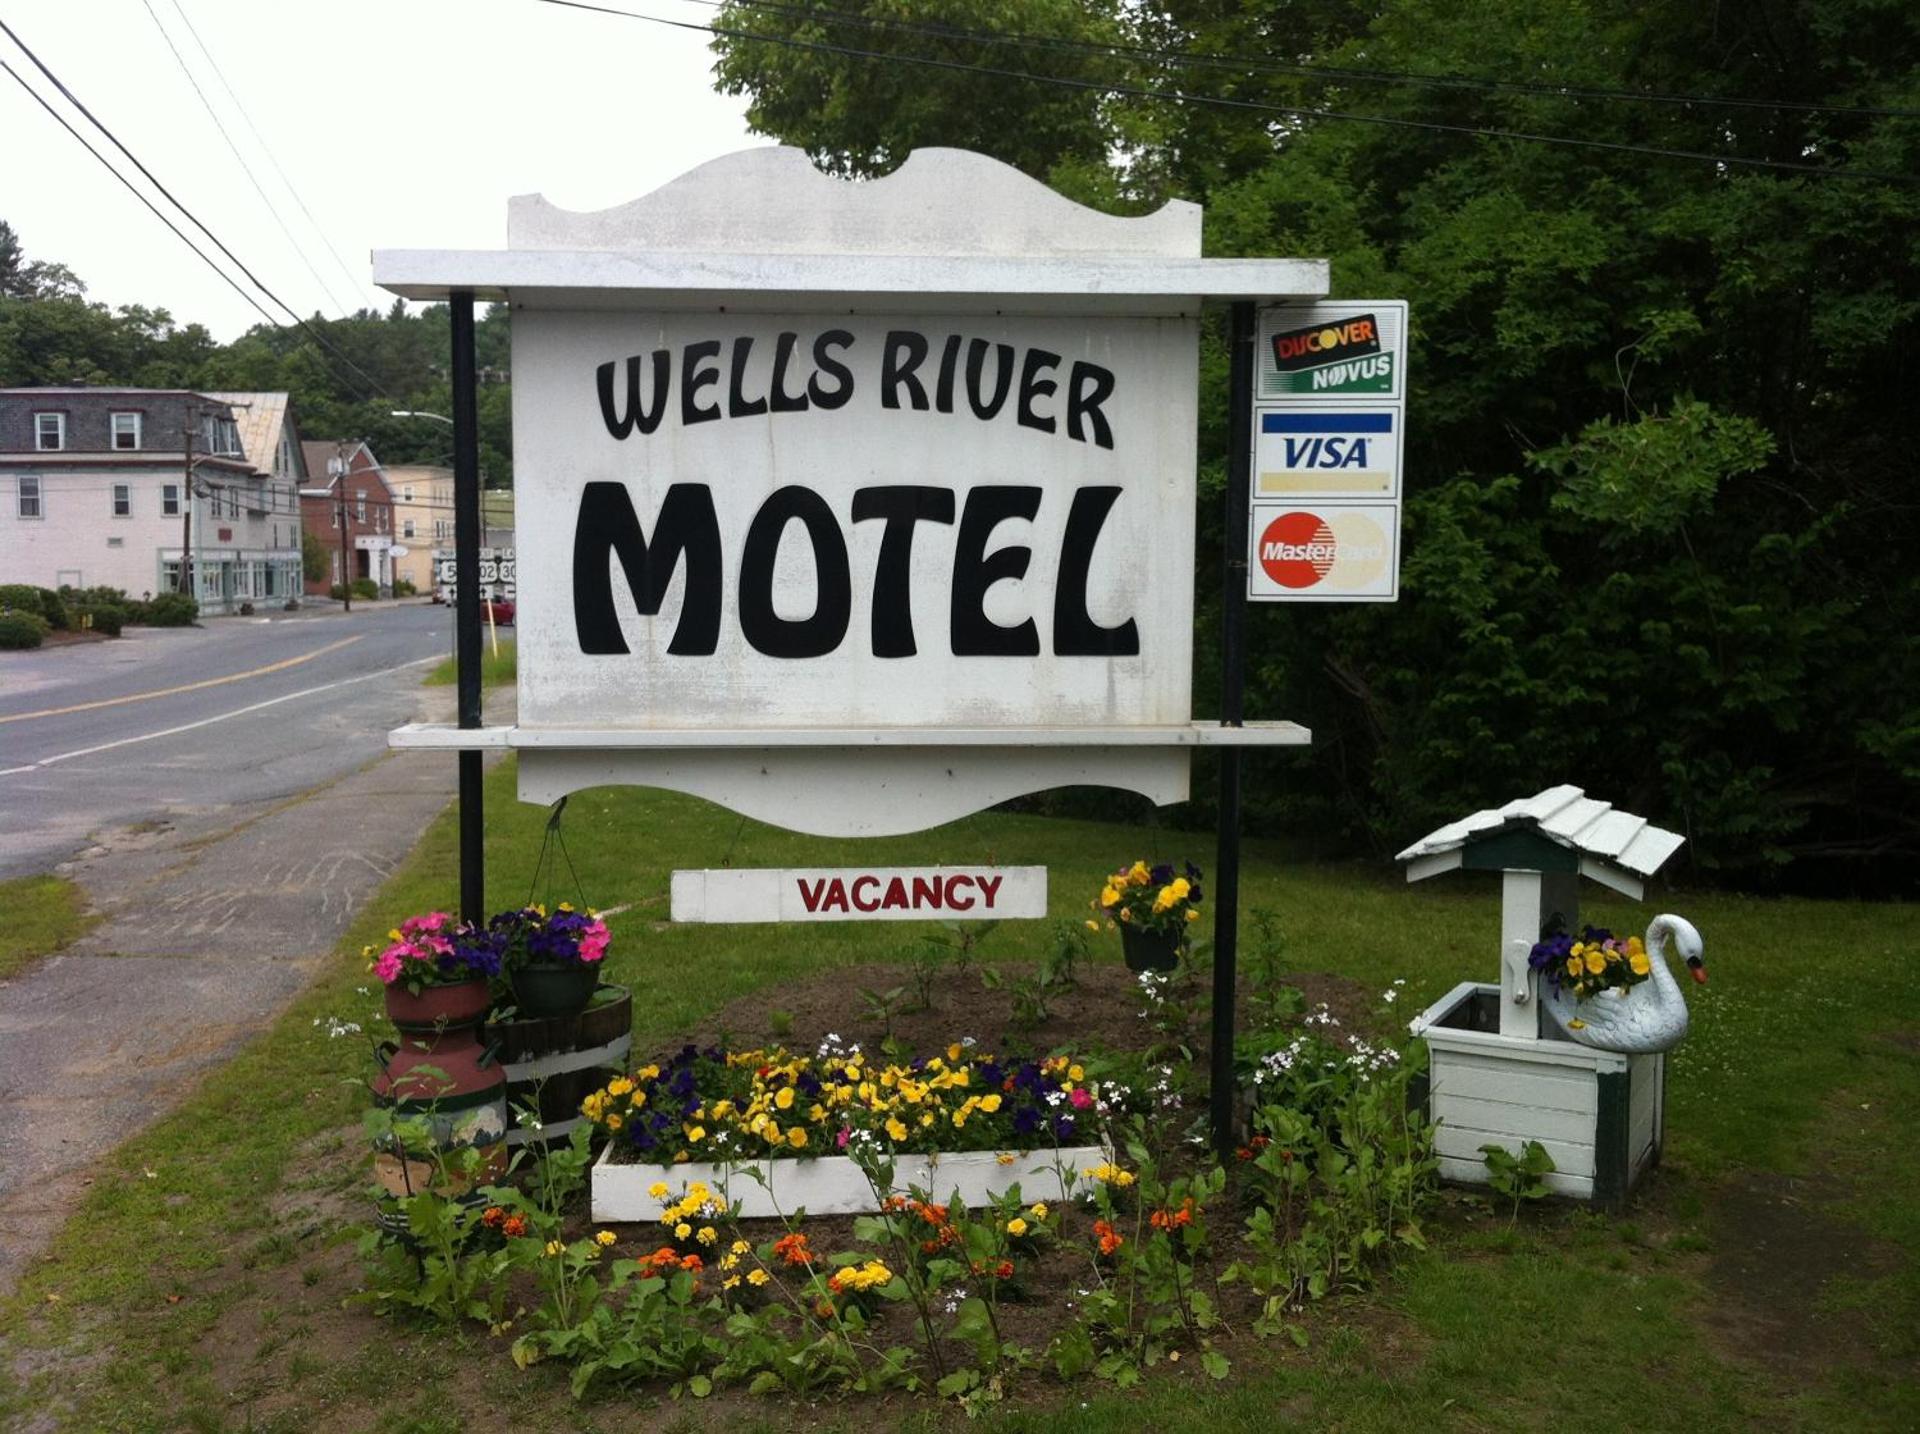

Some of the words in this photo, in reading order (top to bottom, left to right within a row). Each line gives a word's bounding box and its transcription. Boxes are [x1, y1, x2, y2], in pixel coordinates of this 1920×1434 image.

[1278, 319, 1374, 359] DISCOVER
[596, 329, 855, 440] WELLS
[880, 331, 1115, 451] RIVER
[1312, 355, 1391, 390] NOVUS
[1283, 437, 1367, 468] VISA
[573, 481, 1140, 659] MOTEL
[796, 875, 1003, 913] VACANCY
